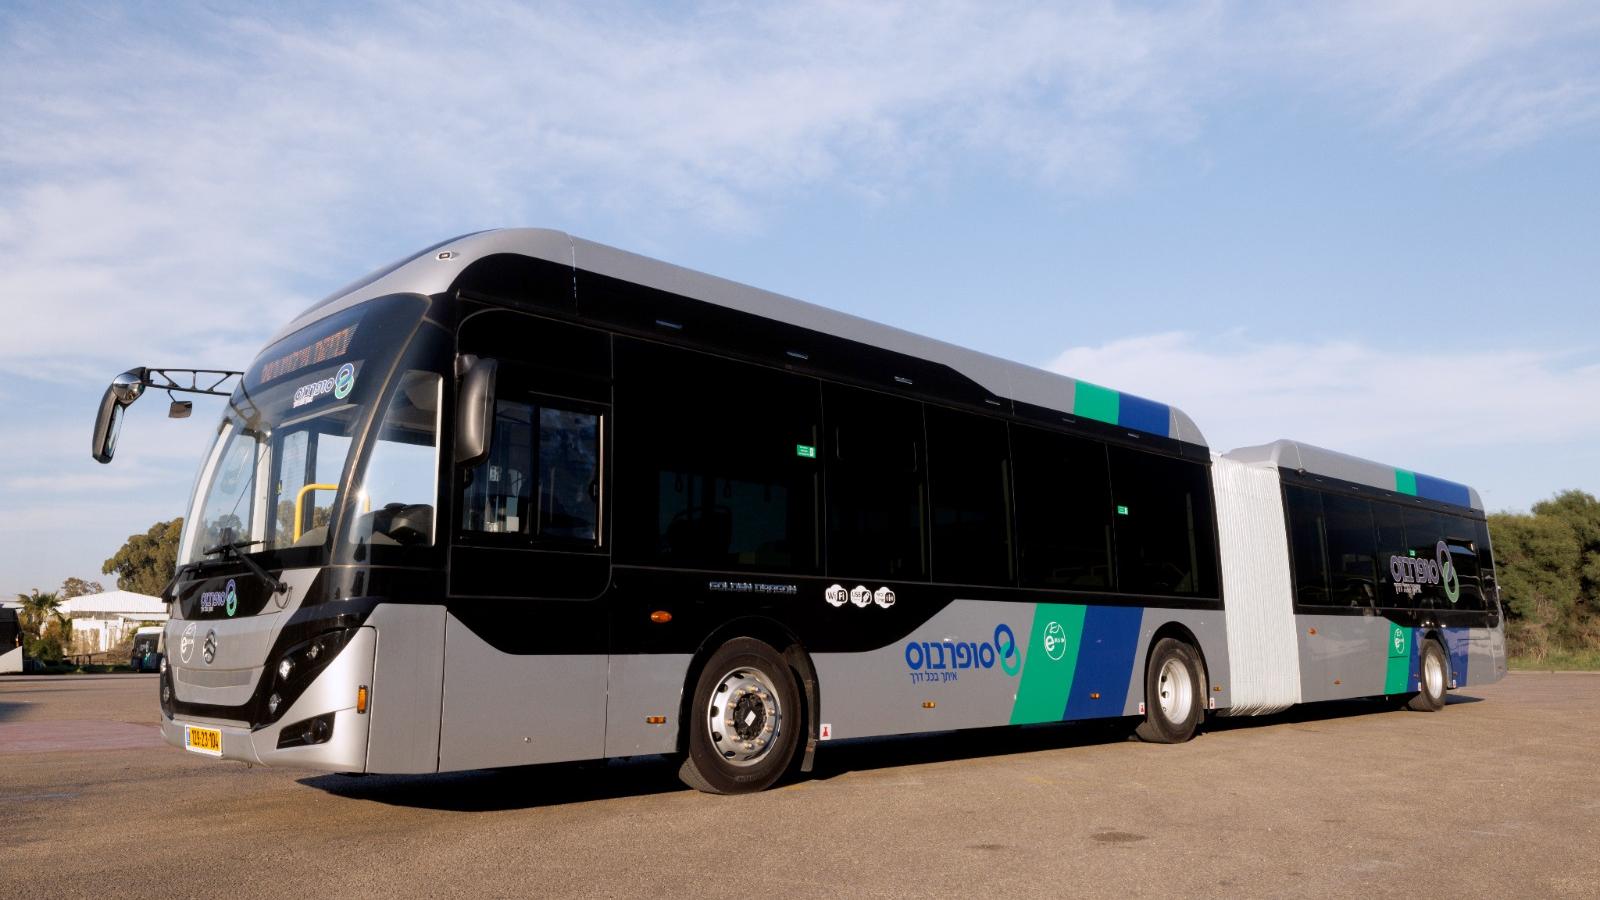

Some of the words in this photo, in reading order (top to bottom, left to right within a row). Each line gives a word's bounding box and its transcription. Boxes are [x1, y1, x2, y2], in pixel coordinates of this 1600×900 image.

[1390, 555, 1440, 585] סופרבוס
[905, 641, 995, 670] סופרבוס
[910, 672, 924, 685] דרך
[925, 670, 939, 682] בכל
[941, 671, 958, 683] איתך
